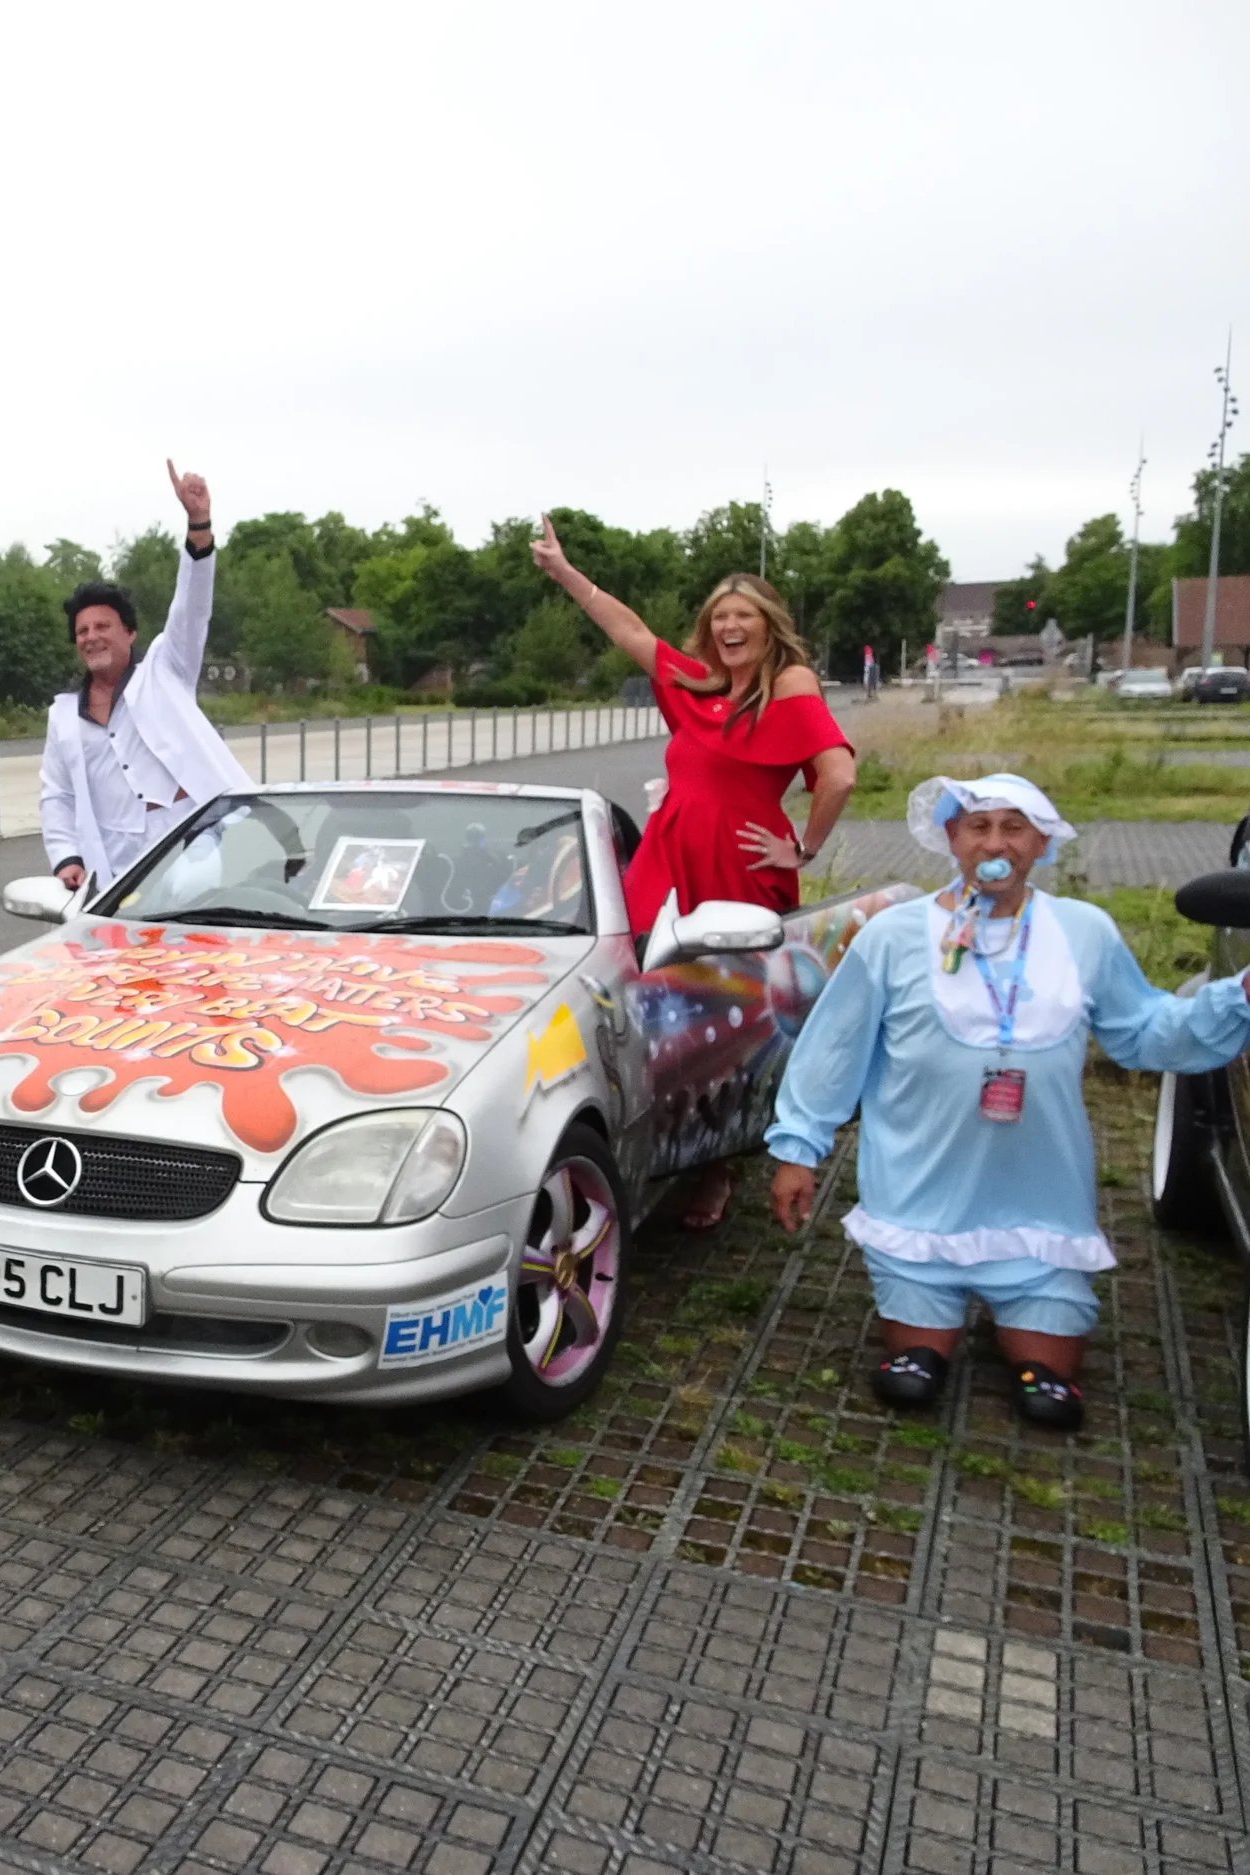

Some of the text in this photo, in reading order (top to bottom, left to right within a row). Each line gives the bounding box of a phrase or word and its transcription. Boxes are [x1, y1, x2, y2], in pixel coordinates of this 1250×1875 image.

[158, 968, 264, 990] LIFE
[264, 973, 493, 1023] MATTERS
[280, 954, 461, 993] ALIVE
[42, 981, 404, 1032] VERY BEAT
[7, 1008, 283, 1070] COUNTS
[40, 1265, 125, 1316] CLJ
[384, 1287, 507, 1355] EHMF
